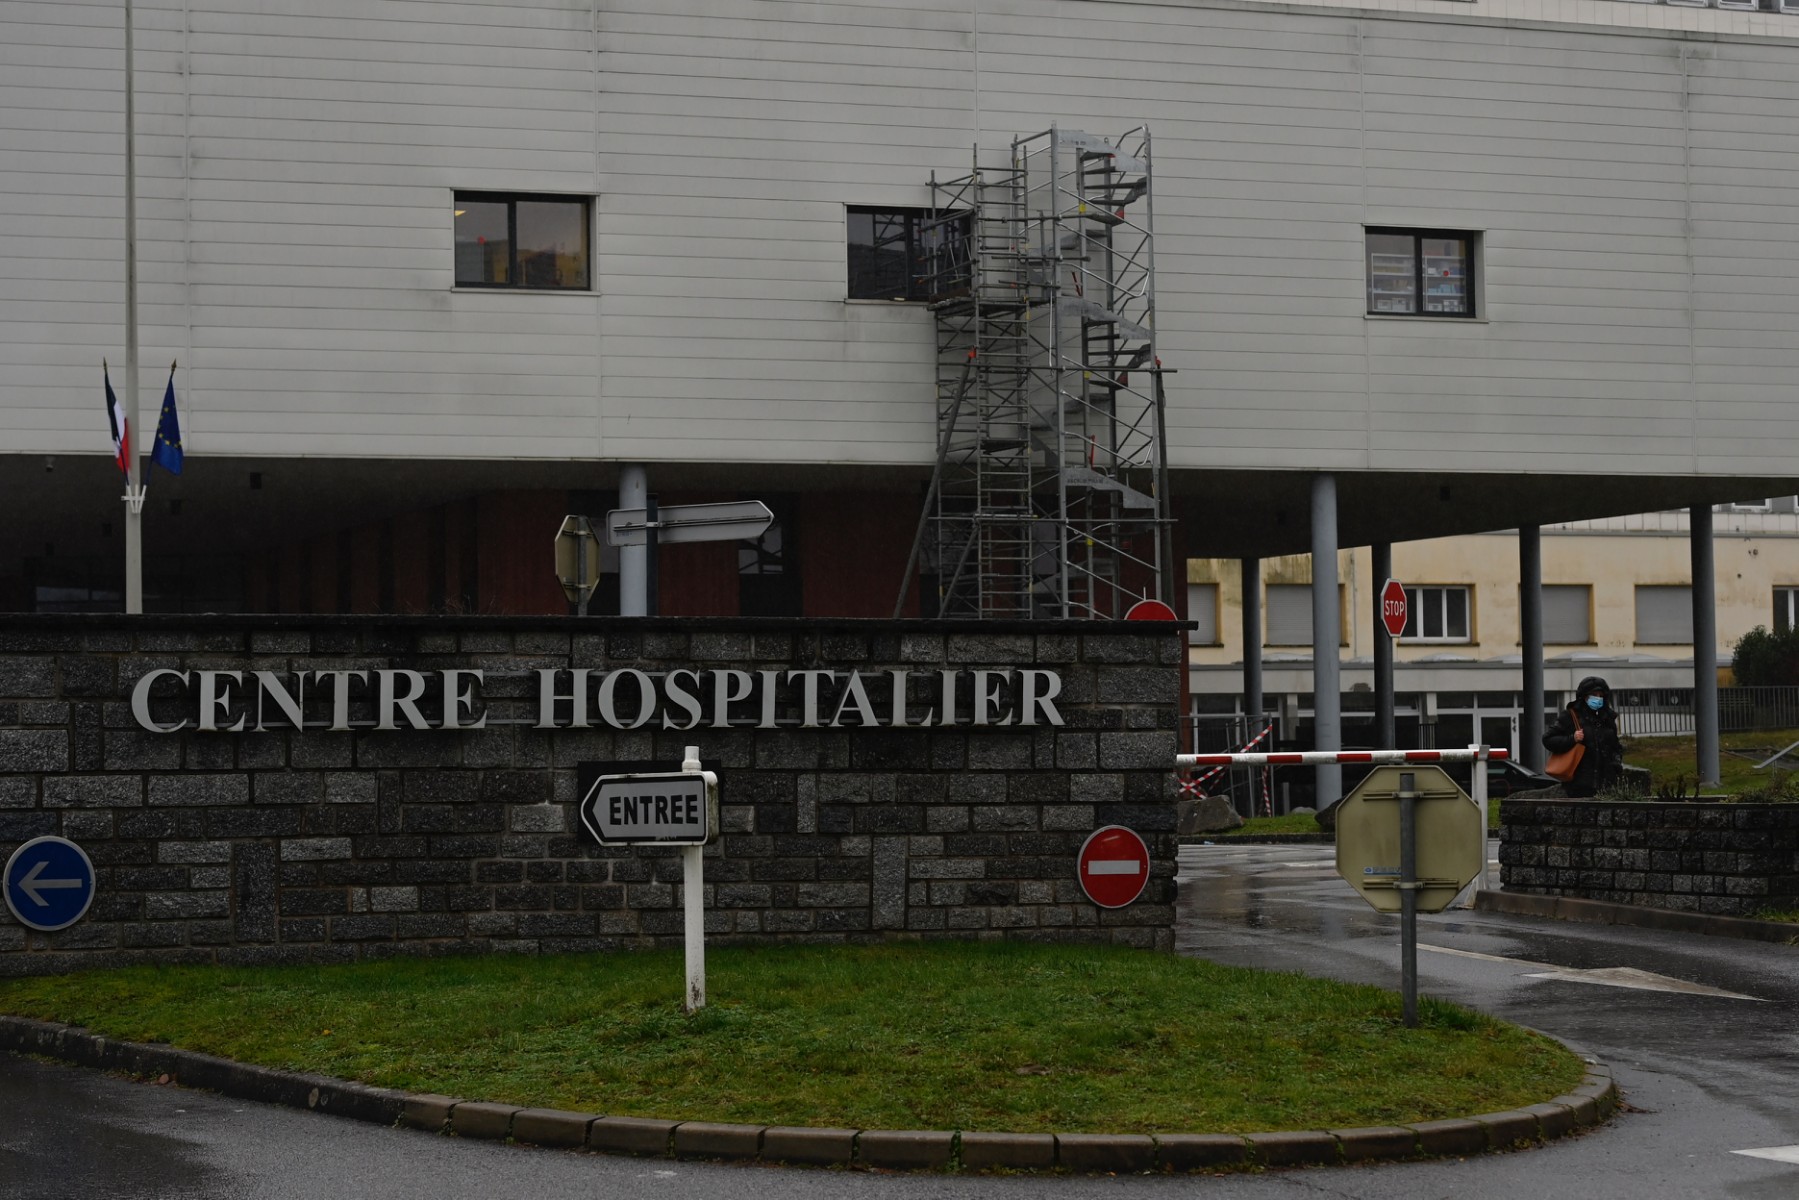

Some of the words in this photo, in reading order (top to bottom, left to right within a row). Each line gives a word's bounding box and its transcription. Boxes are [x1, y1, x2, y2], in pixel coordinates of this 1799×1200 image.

[1385, 600, 1404, 617] STOP
[131, 668, 488, 733] CENTRE
[533, 667, 1065, 730] HOSPITALIER
[609, 794, 699, 825] ENTREE
